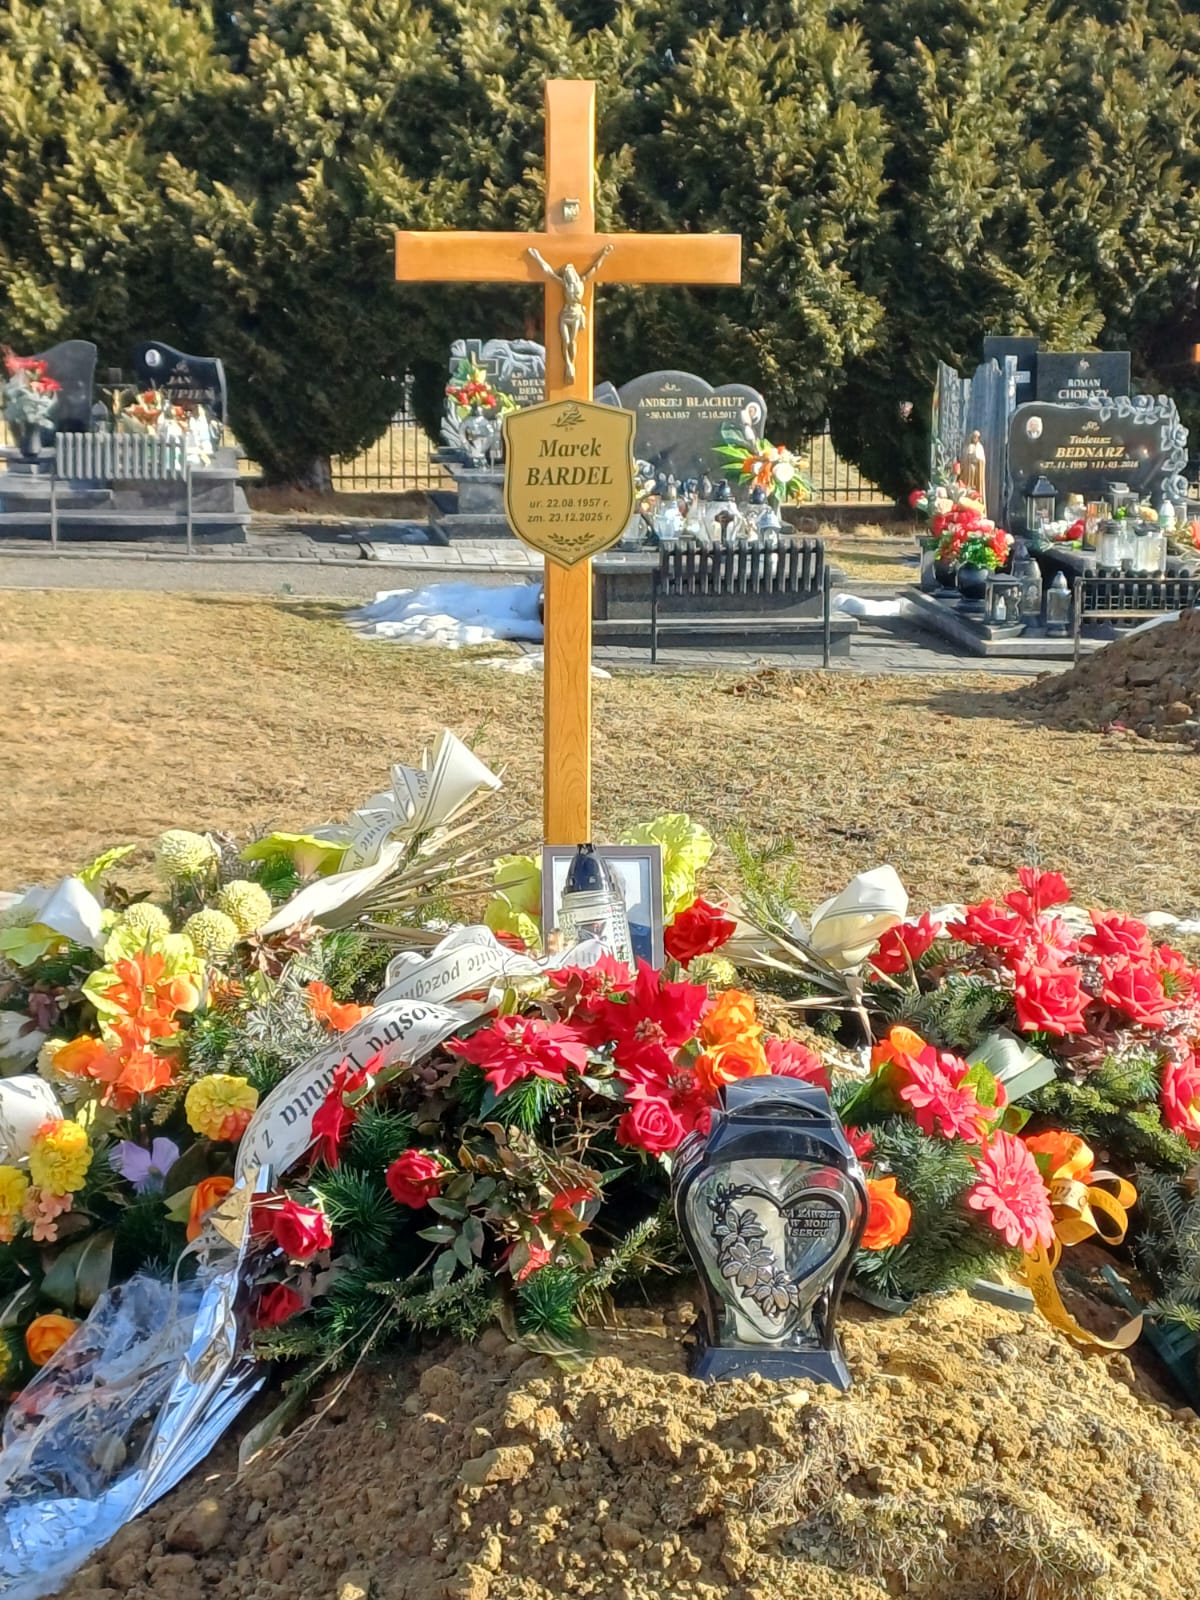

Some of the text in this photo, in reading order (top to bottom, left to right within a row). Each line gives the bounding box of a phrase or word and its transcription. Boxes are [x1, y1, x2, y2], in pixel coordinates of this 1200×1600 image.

[1067, 378, 1101, 387] ROMAN
[638, 398, 682, 407] ANDRZEJ
[538, 437, 602, 458] Marek
[1055, 447, 1126, 458] BEDNARZ
[525, 466, 613, 486] BARDEL
[529, 498, 611, 508] ur. 22.08.1957 r.
[527, 512, 613, 523] zm. 23.12.2025 r.
[366, 1006, 440, 1052] iostra
[780, 1208, 794, 1218] NA
[790, 1218, 801, 1227] W
[791, 1228, 829, 1237] SERCU
